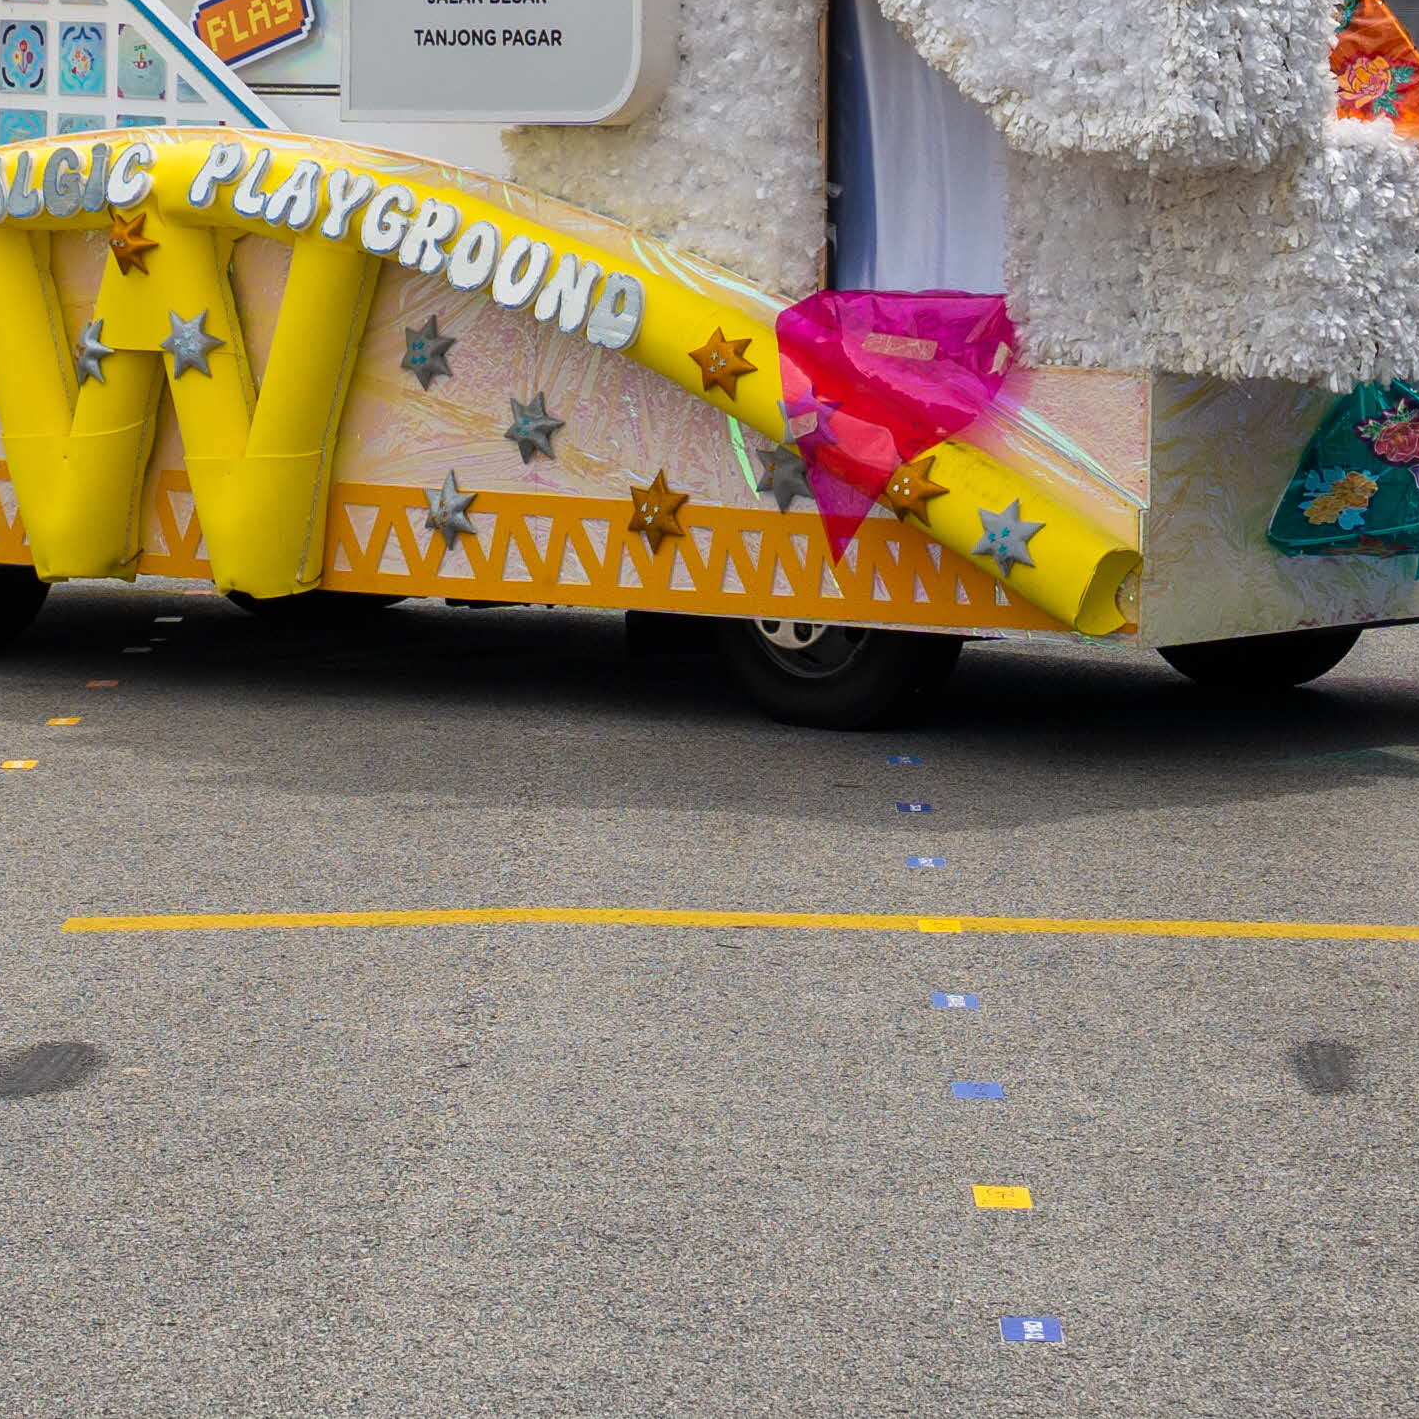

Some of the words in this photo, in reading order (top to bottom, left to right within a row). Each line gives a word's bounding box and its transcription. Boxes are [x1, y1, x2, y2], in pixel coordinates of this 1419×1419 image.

[415, 29, 496, 47] TANJONG
[502, 28, 562, 46] PAGAR
[187, 142, 646, 350] PLAYGROUND
